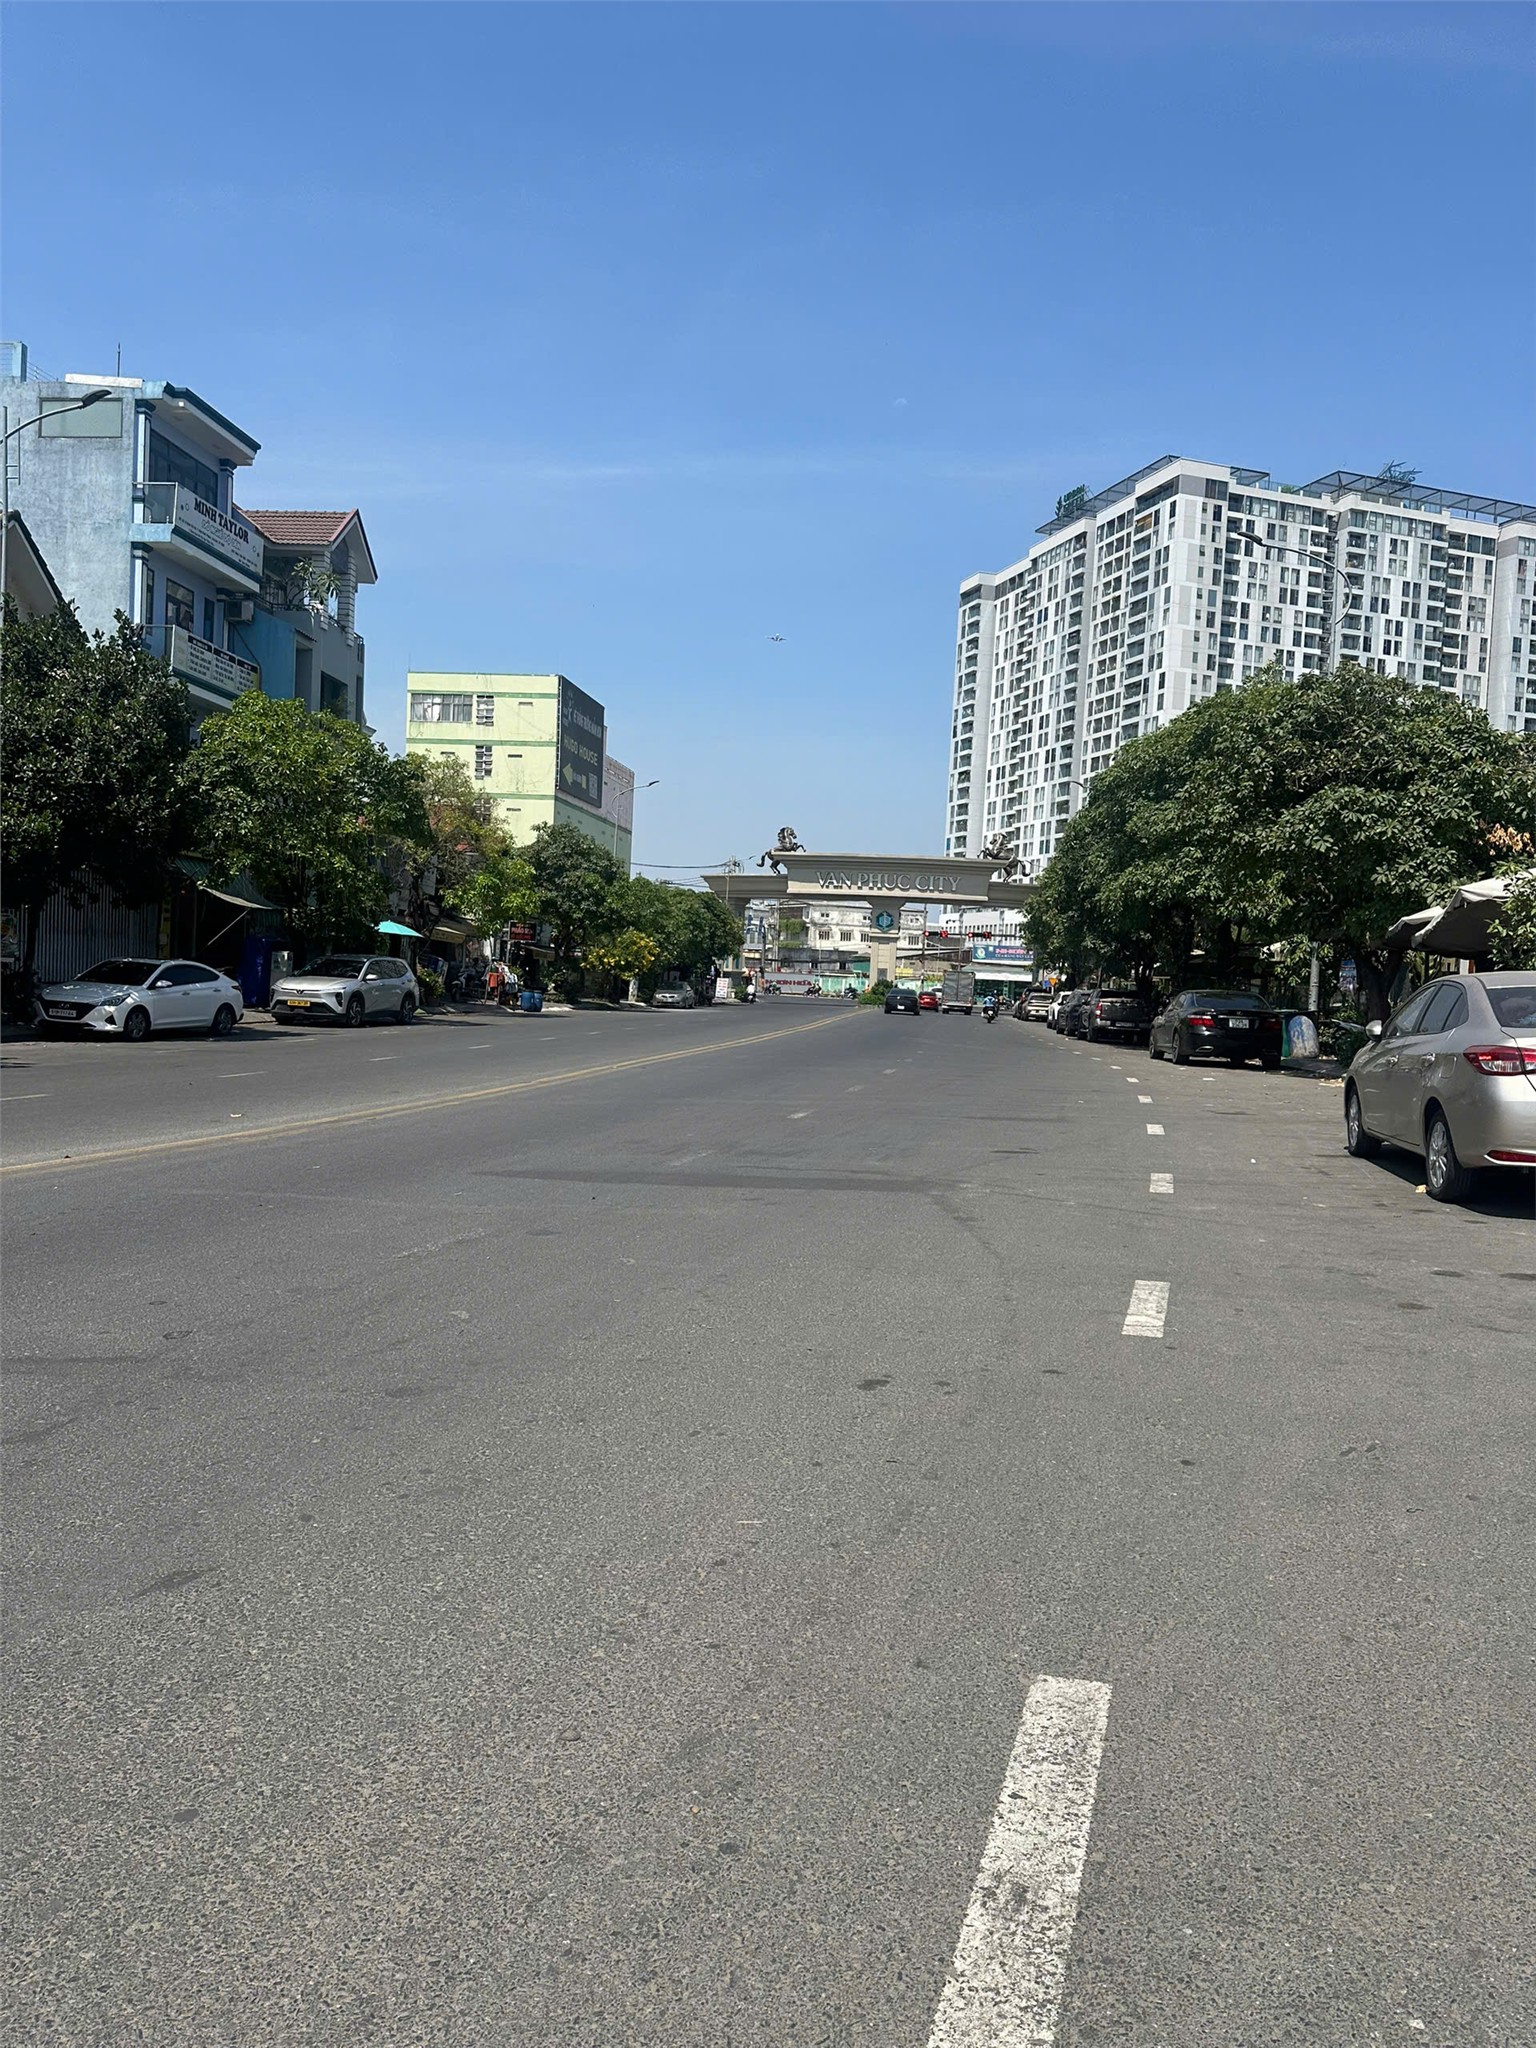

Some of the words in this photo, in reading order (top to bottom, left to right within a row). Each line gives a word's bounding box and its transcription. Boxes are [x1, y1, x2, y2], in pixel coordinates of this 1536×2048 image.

[194, 498, 217, 523] MINH
[218, 512, 249, 544] TAYLOR
[579, 745, 598, 766] HOUSE
[816, 871, 851, 888] VAN
[857, 872, 910, 890] PHUC
[915, 875, 961, 892] CITY
